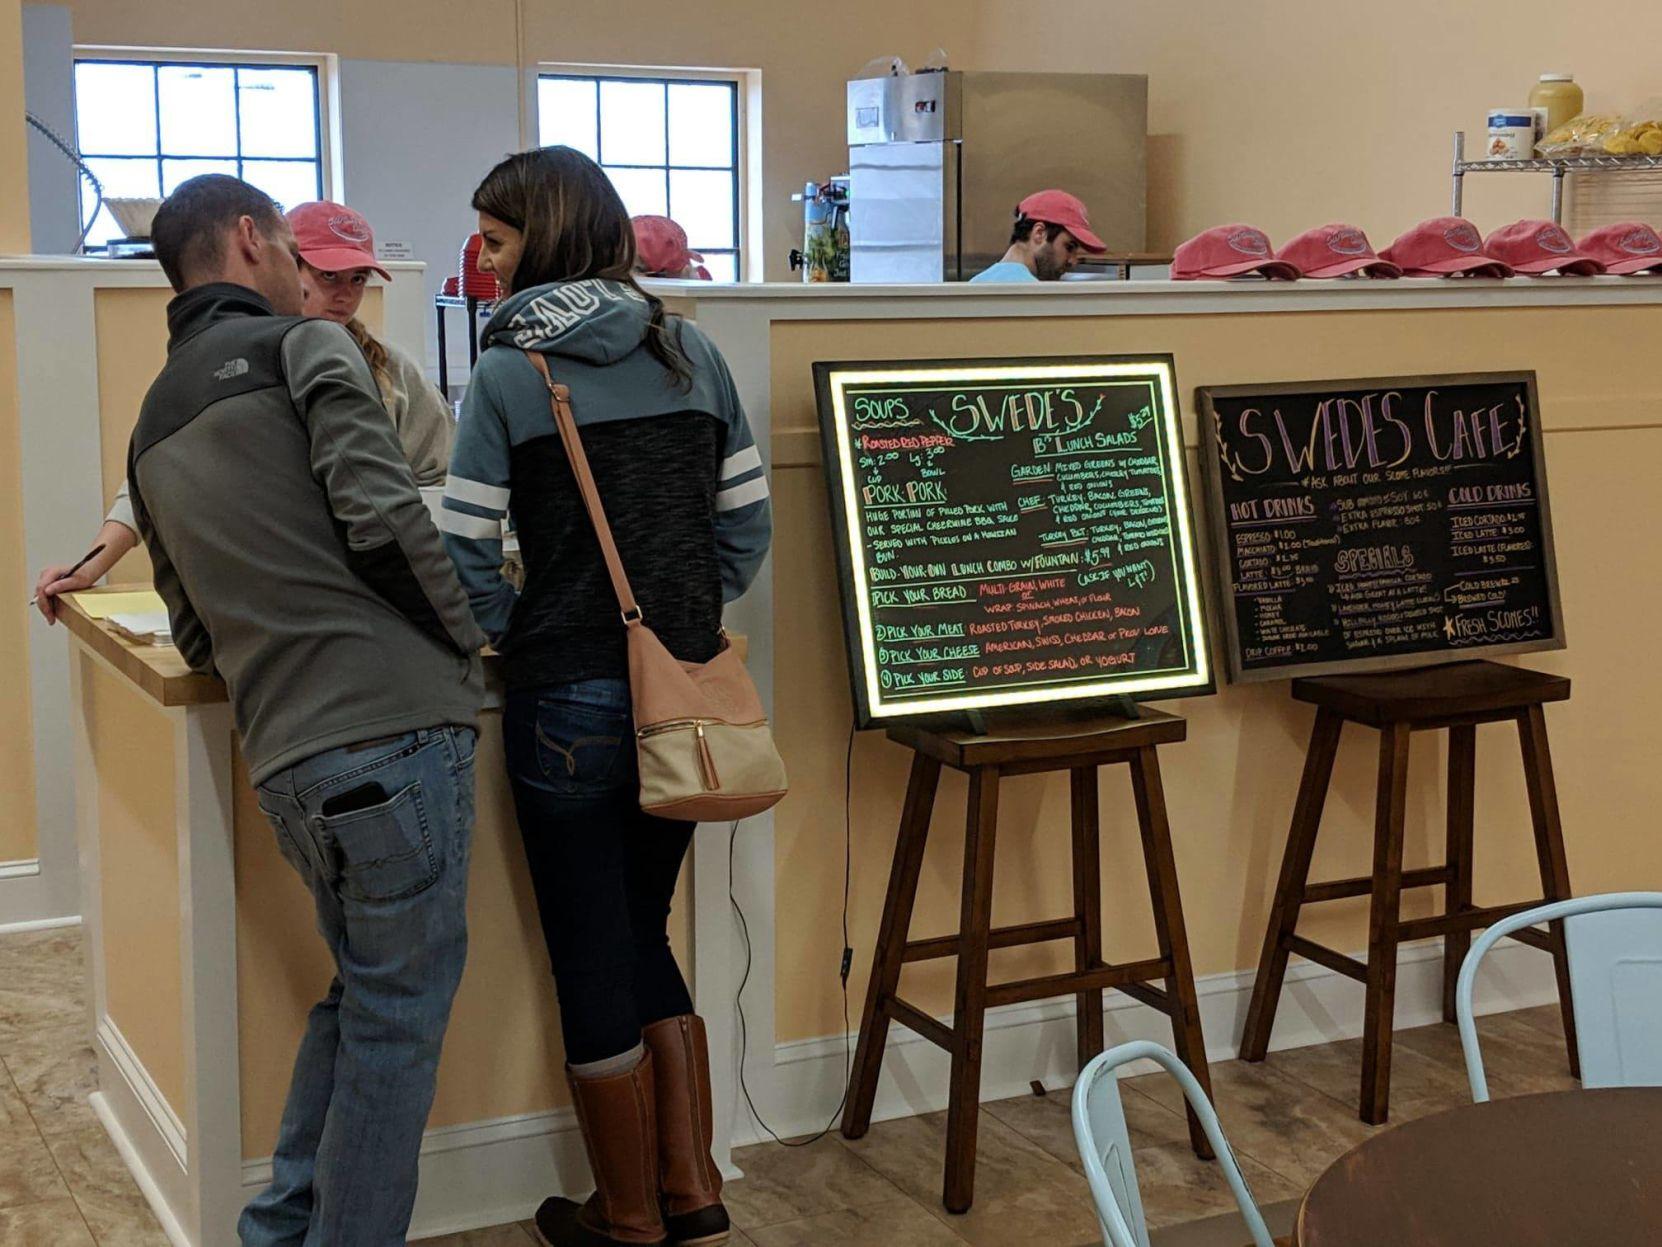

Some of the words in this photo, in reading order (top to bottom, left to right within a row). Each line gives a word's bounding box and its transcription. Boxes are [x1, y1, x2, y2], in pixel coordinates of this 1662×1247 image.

[854, 397, 910, 421] SOUPS
[900, 438, 920, 449] RED
[1055, 435, 1094, 454] LUNCH
[1095, 431, 1138, 448] SALADS
[1235, 391, 1411, 474] SWEDES
[1425, 391, 1515, 460] CAFE
[867, 475, 882, 485] CUP
[920, 467, 947, 479] BOWL
[1011, 463, 1051, 478] GARDEN
[1333, 473, 1358, 487] ABOUT
[1362, 472, 1381, 485] OUR
[1448, 486, 1484, 503] COLD
[1487, 482, 1532, 501] DRINKS
[866, 511, 890, 522] HUGE
[926, 506, 937, 517] OF
[986, 501, 1008, 513] WITH
[1230, 500, 1258, 521] HOT
[1263, 495, 1315, 518] DRINKS
[867, 525, 886, 536] OUR
[891, 524, 924, 535] SPECIAL
[974, 516, 995, 526] BBQ
[905, 536, 928, 546] WITH
[962, 532, 972, 541] ON
[951, 562, 984, 577] LUNCH
[987, 560, 1018, 572] COMBO
[1335, 545, 1413, 573] SPECIALS
[904, 588, 930, 603] YOUR
[932, 585, 967, 600] BREAD
[1039, 578, 1066, 590] WHITE
[887, 626, 908, 639] PICK
[911, 624, 935, 636] YOUR
[938, 622, 964, 635] MEAT
[969, 620, 1008, 635] ROASTED
[1114, 606, 1140, 618] BACON
[1455, 613, 1488, 637] FRESH
[890, 650, 911, 663] PICK
[915, 646, 940, 660] YOUR
[943, 644, 980, 659] CHEESE
[1064, 631, 1108, 644] CHEDDAR
[893, 673, 915, 686] PICK
[918, 671, 941, 683] YOUR
[942, 668, 965, 680] SIDE
[972, 666, 988, 677] CUP
[992, 665, 1003, 674] OF
[1028, 660, 1047, 671] SIDE
[1095, 652, 1136, 668] YOGURT
